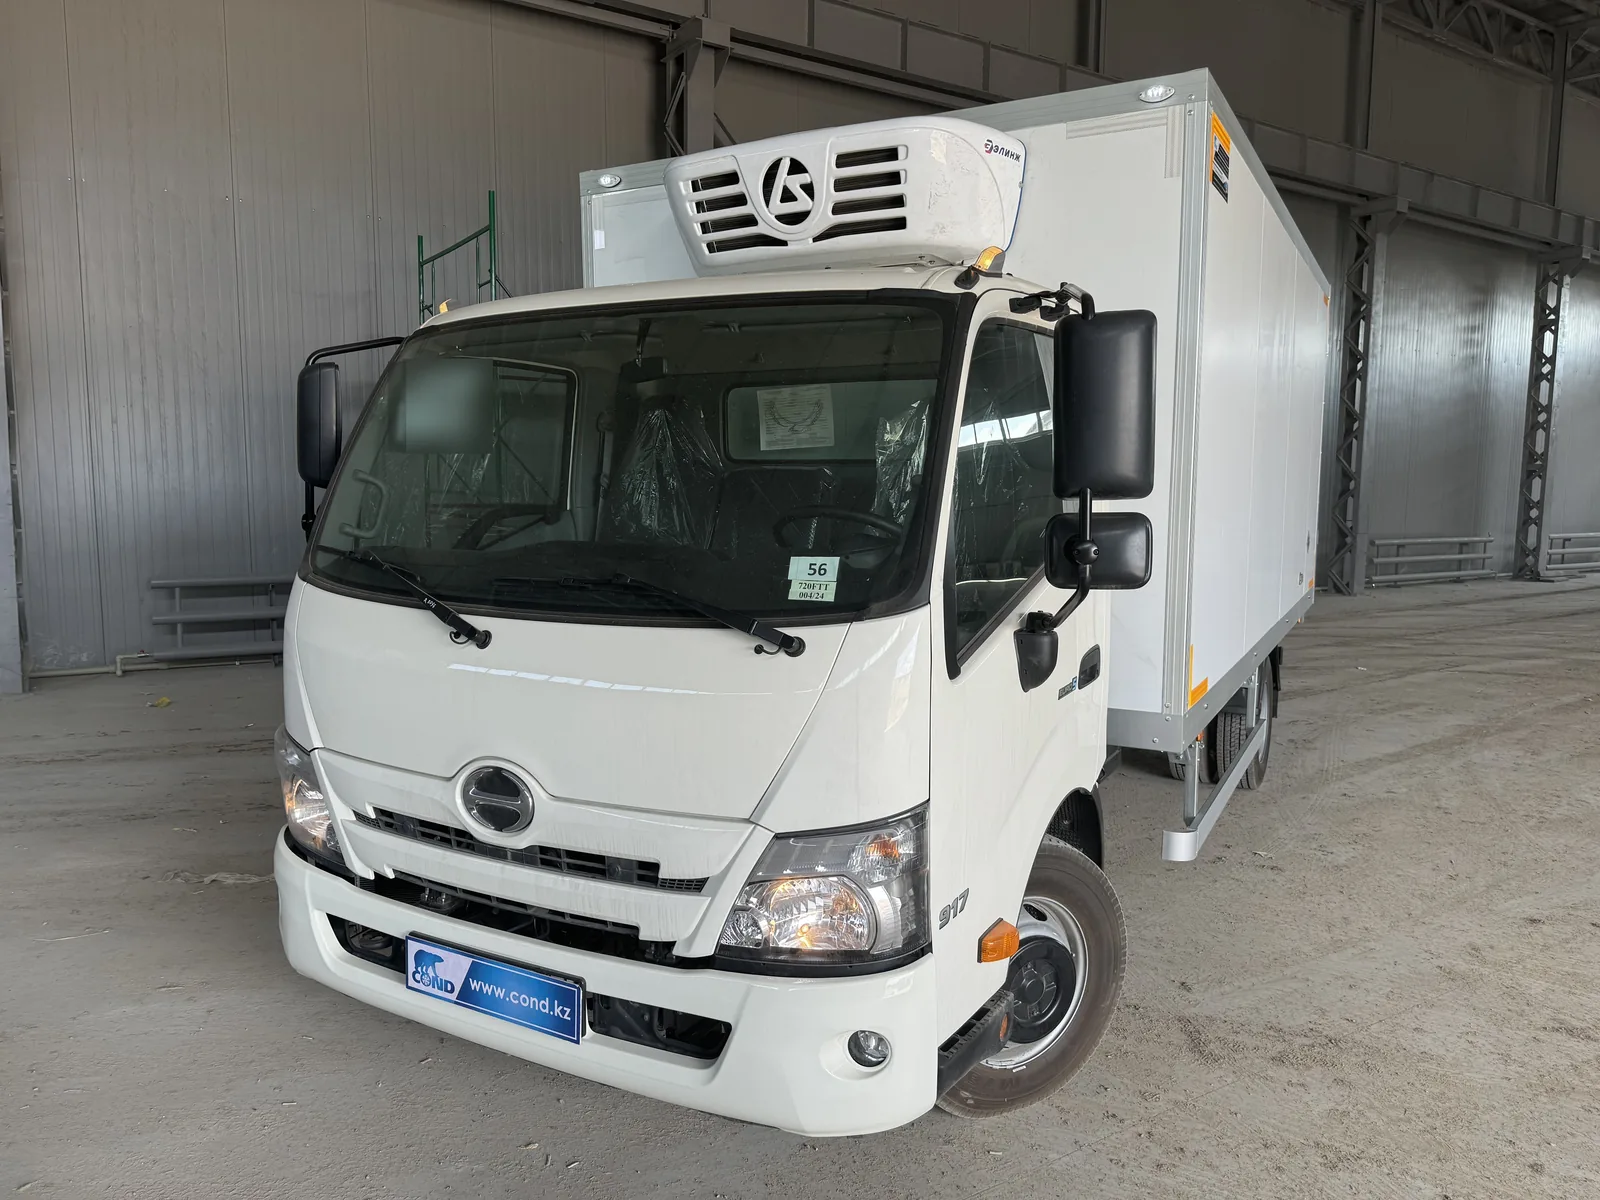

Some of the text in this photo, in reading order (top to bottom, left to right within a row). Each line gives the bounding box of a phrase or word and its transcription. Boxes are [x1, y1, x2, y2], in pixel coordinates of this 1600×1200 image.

[807, 562, 828, 576] 56
[798, 582, 830, 590] 720FTT
[939, 887, 970, 930] 917
[411, 969, 455, 994] COND
[469, 977, 572, 1021] www.cond.kz
